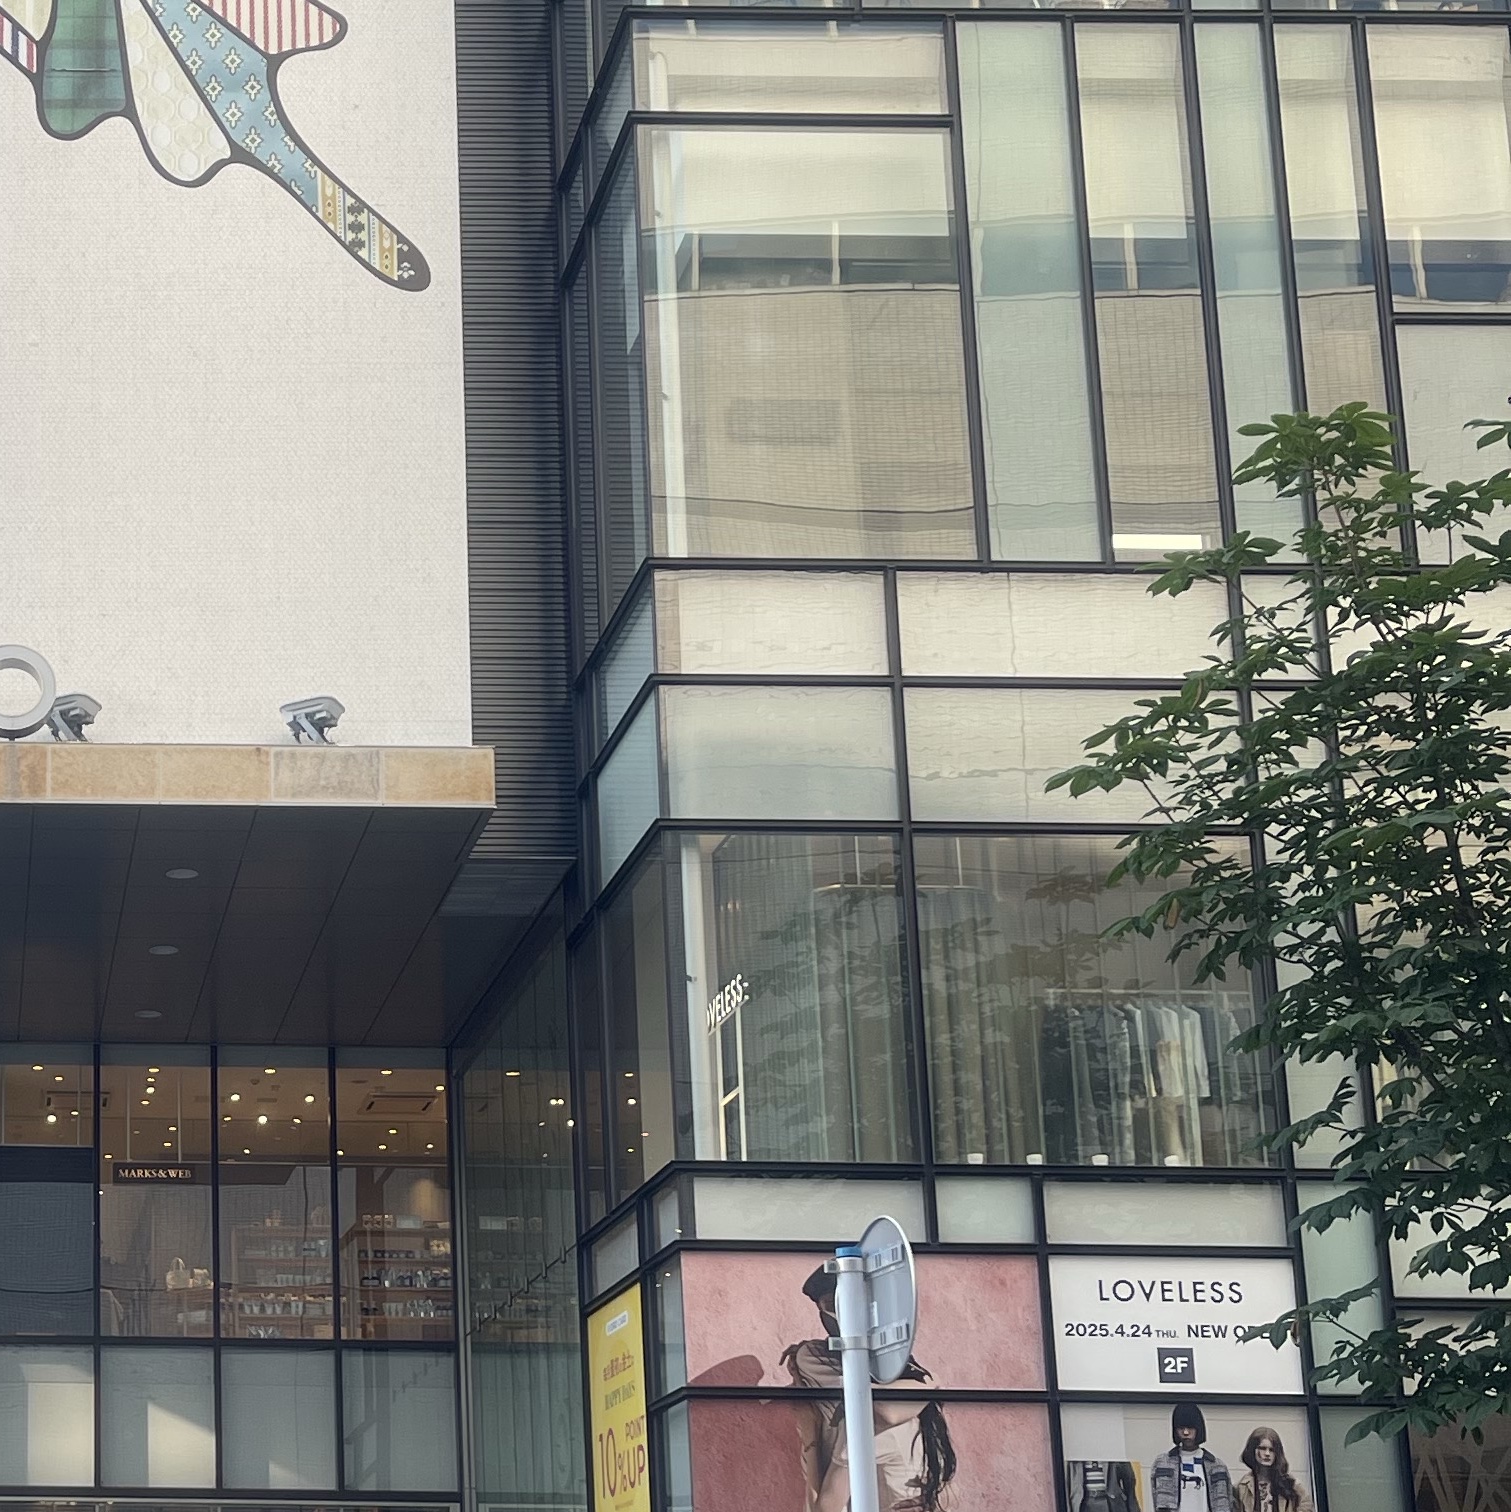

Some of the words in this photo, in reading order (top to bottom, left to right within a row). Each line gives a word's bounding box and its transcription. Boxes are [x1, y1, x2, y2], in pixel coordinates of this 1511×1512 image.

[118, 1168, 192, 1179] MARKS&WEB
[1098, 1279, 1243, 1304] LOVELESS
[1064, 1323, 1153, 1338] 2025.4.24
[1155, 1329, 1180, 1339] THU.
[1187, 1324, 1228, 1339] NEW
[1163, 1356, 1189, 1374] 2F
